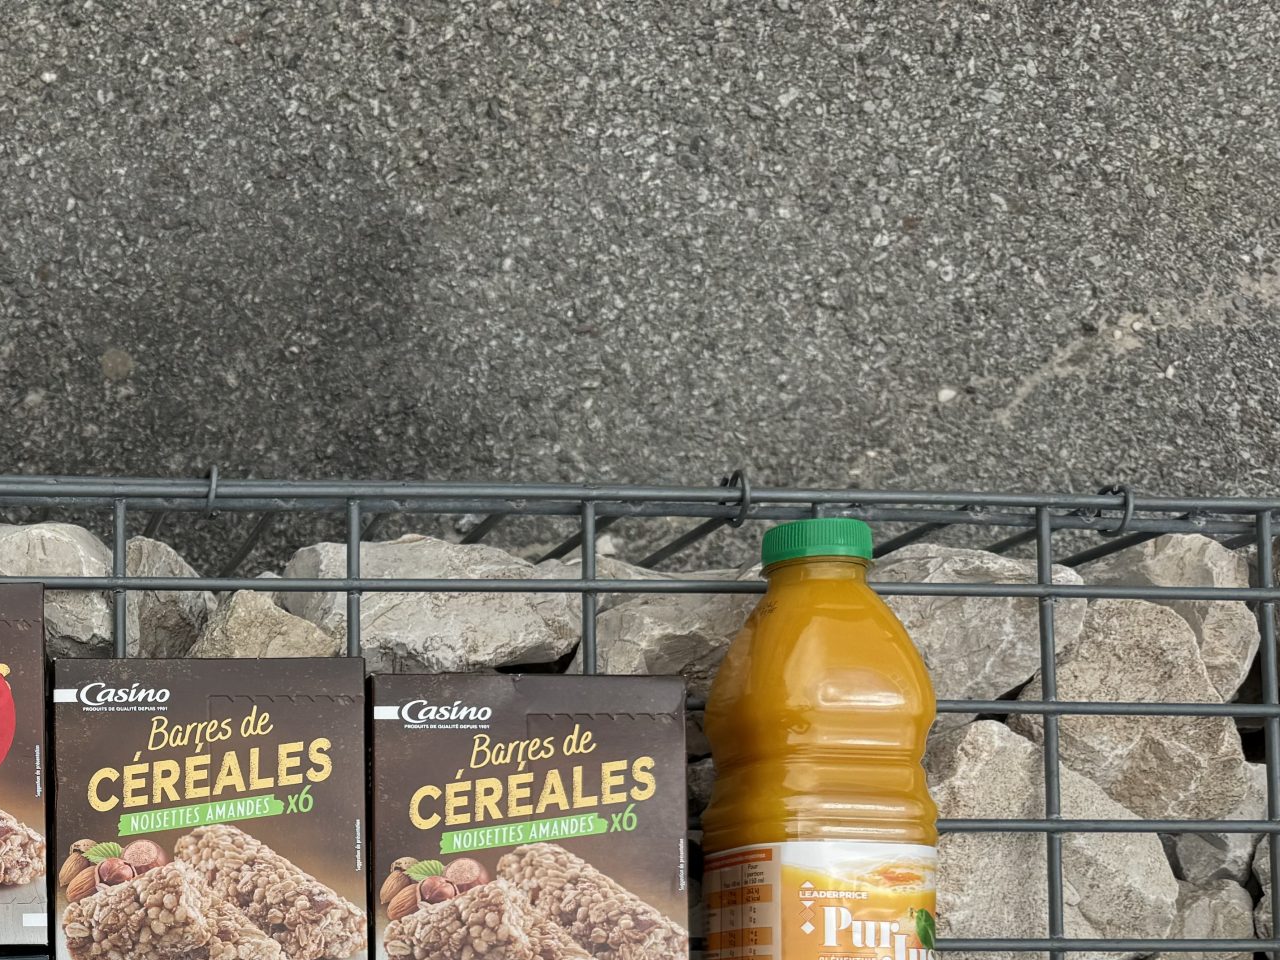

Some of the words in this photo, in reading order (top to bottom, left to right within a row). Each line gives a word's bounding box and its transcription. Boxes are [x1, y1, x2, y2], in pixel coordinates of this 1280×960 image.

[80, 682, 171, 706] Casino
[401, 699, 492, 723] Casino
[147, 715, 232, 752] Barres
[240, 704, 274, 736] de
[469, 733, 556, 769] Barres
[562, 724, 597, 756] de
[87, 737, 334, 813] CÉRÉALES
[286, 784, 314, 815] x6
[408, 755, 657, 831] CÉRÉALES
[130, 808, 201, 833] NOISETTES
[205, 797, 271, 823] AMANDES
[453, 826, 524, 850] NOISETTES
[529, 815, 595, 840] AMANDES
[610, 803, 637, 833] x6
[799, 890, 868, 900] LEADERPRICE
[822, 906, 900, 948] Pur
